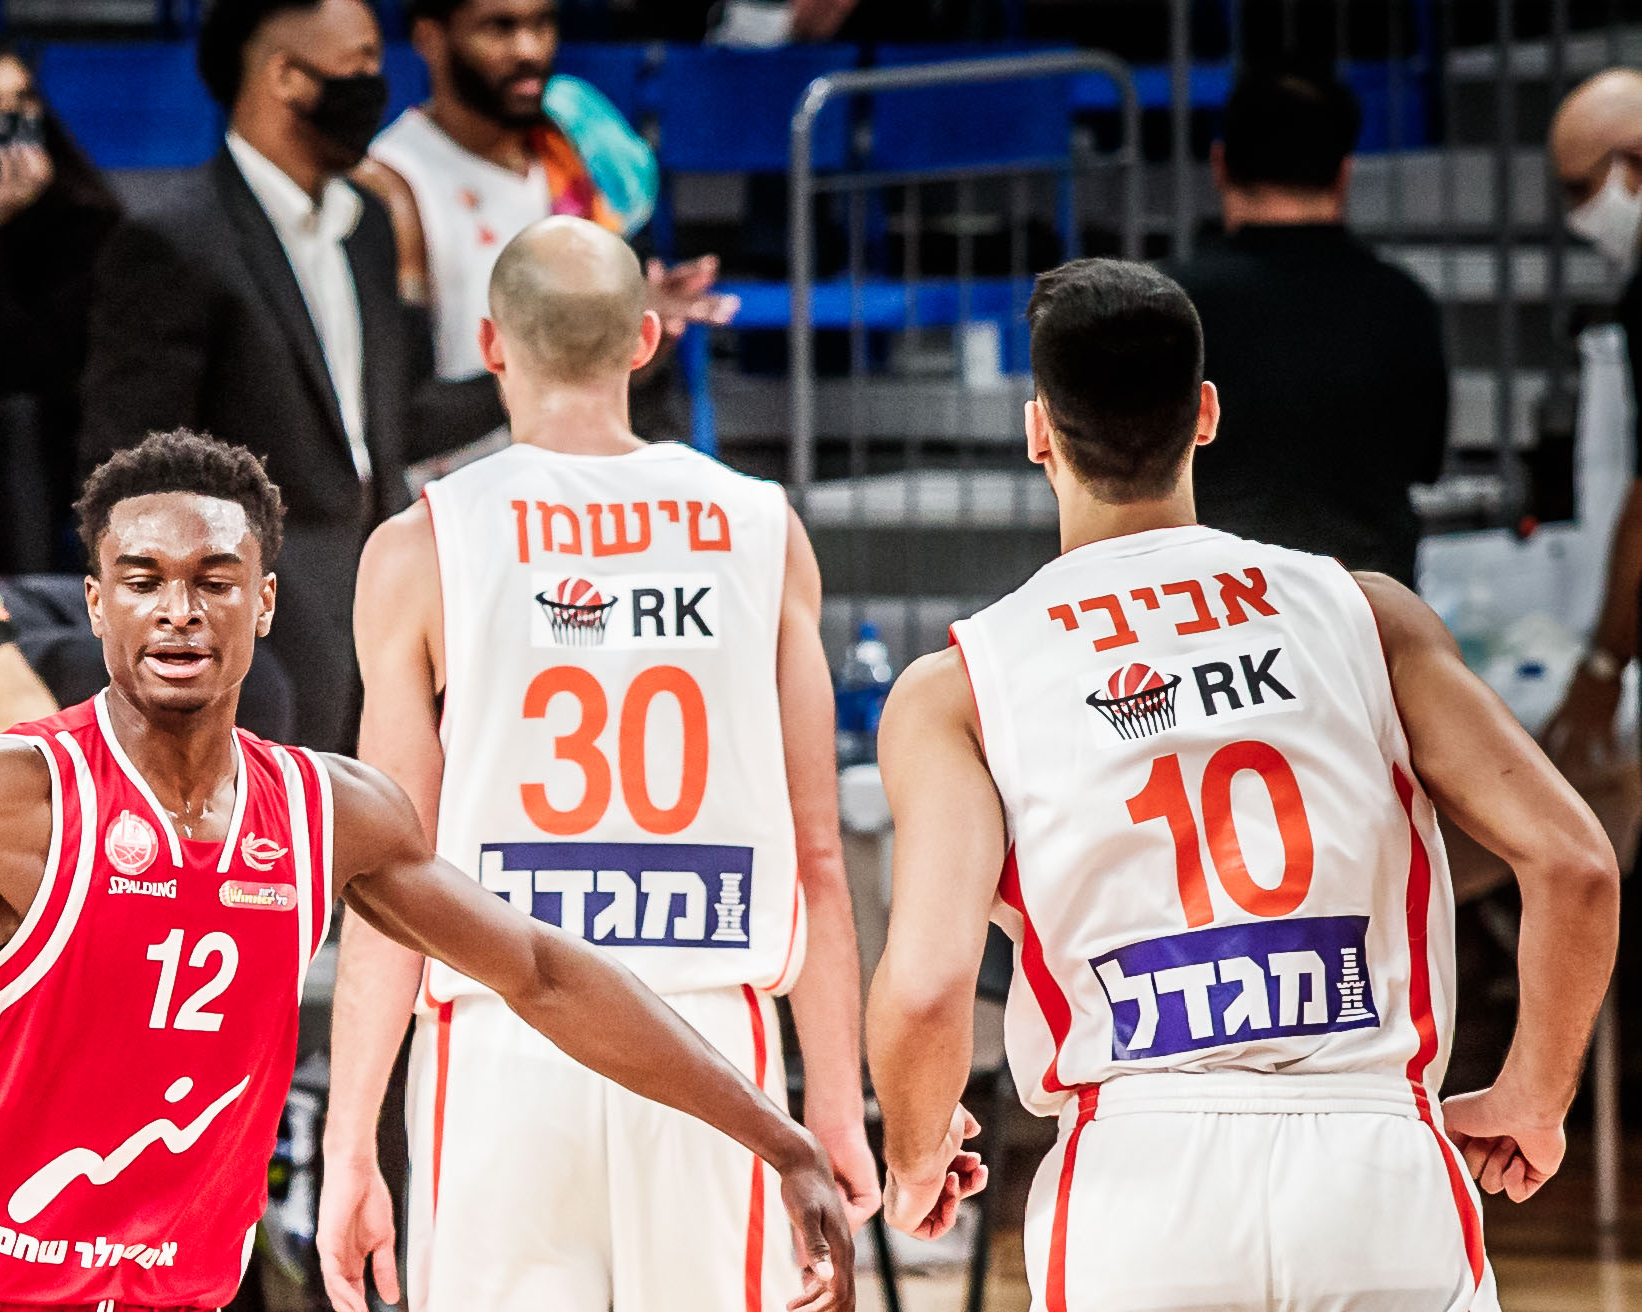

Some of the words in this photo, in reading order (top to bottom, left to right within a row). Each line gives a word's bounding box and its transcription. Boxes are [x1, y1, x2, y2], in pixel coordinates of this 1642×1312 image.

[510, 499, 732, 563] טישמן
[631, 586, 714, 638] RK
[1047, 566, 1280, 653] אביבי
[1191, 646, 1297, 717] RK
[520, 664, 709, 836] 30
[1125, 740, 1315, 929] 10
[108, 875, 178, 899] SPALDING
[229, 887, 276, 905] Winner
[480, 849, 708, 941] מגדל
[146, 928, 240, 1033] 12
[1097, 949, 1329, 1051] מגדל
